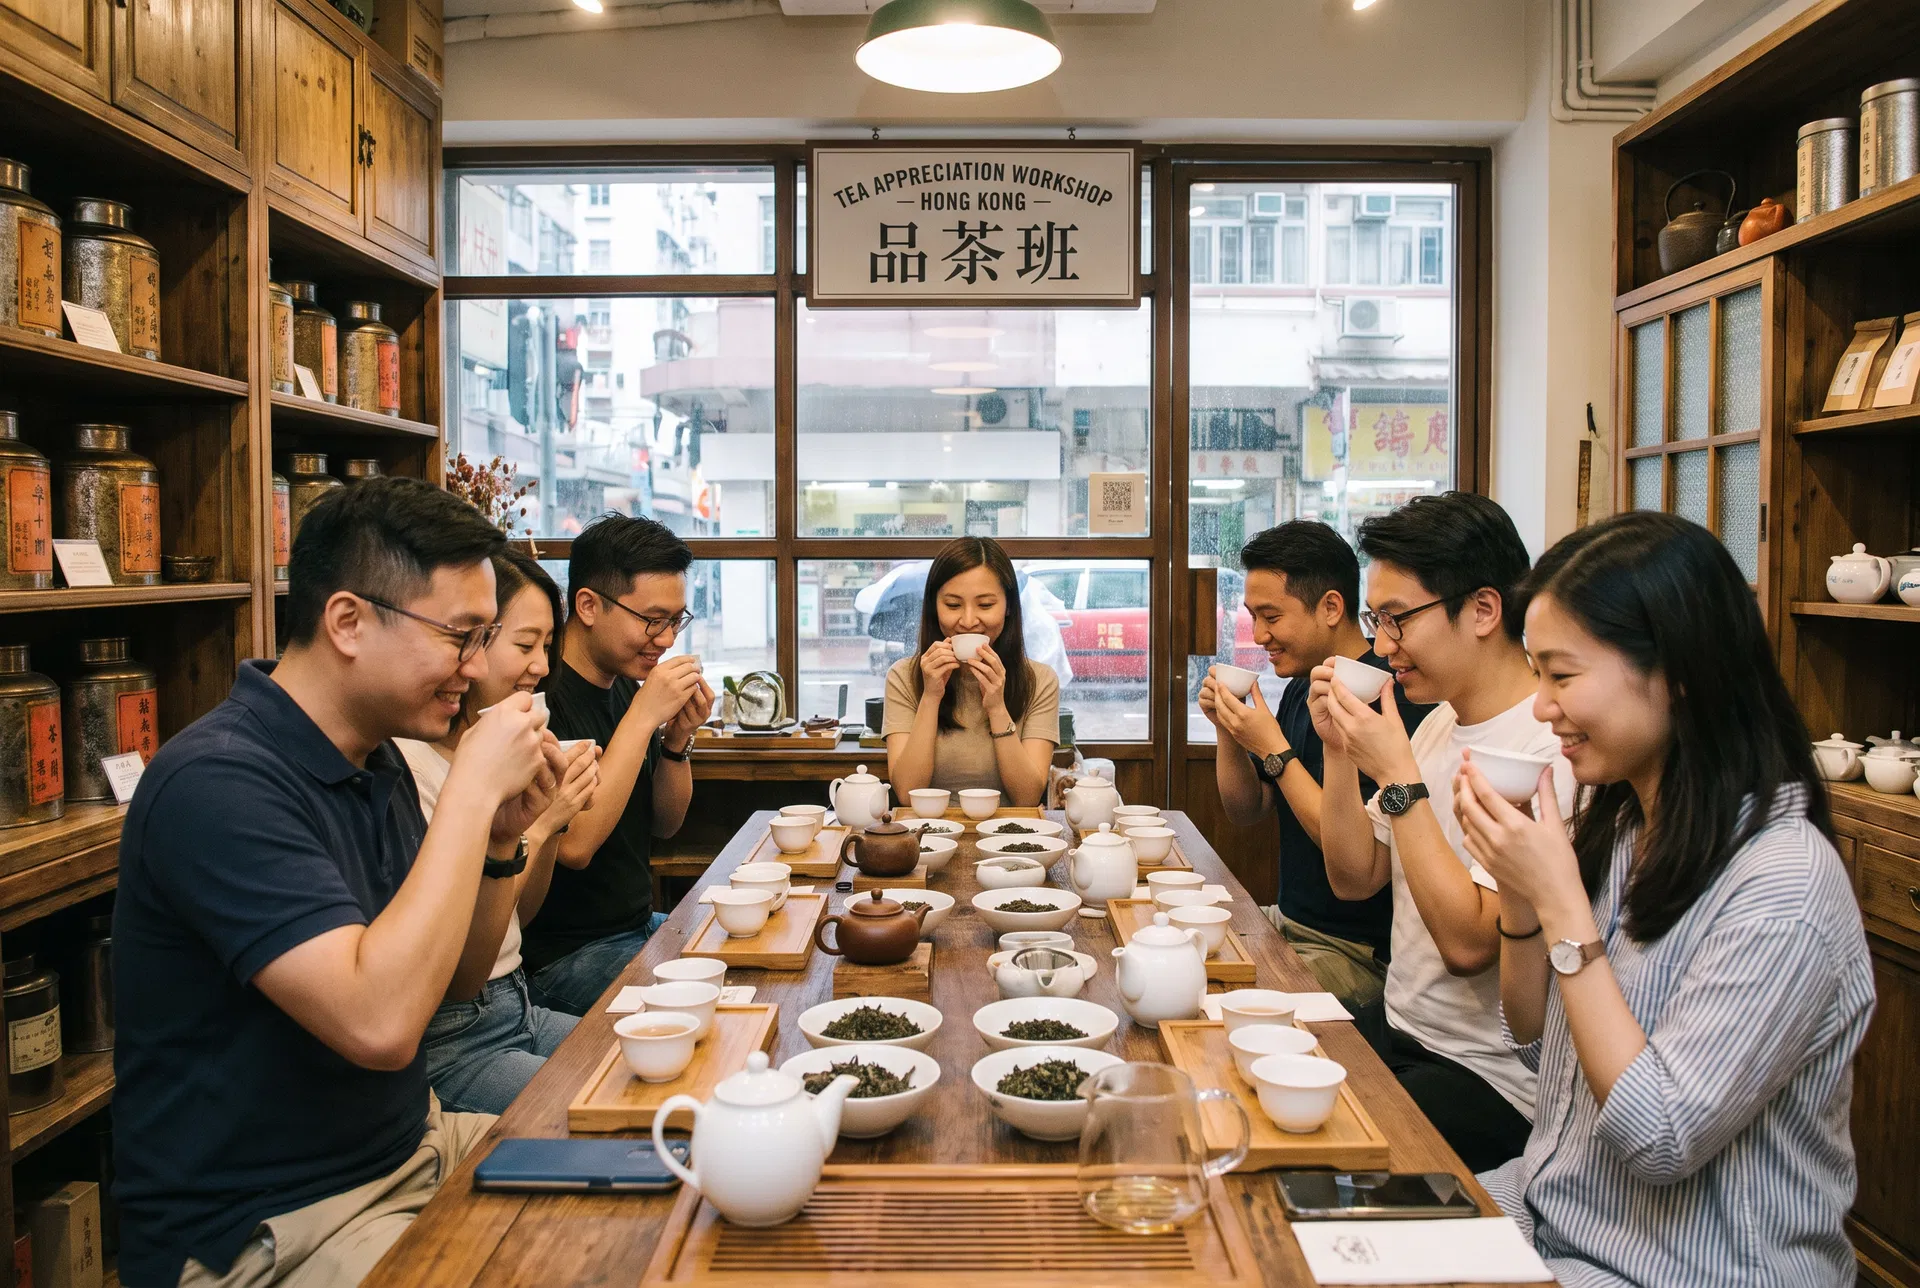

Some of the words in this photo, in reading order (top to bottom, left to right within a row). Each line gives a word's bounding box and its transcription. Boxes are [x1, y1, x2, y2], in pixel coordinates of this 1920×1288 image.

[833, 182, 870, 209] TEA
[874, 162, 1004, 195] APPRECIATION
[1013, 164, 1113, 206] WORKSHOP
[921, 192, 970, 211] HONG
[978, 192, 1026, 211] KONG
[870, 220, 1080, 284] 品茶班
